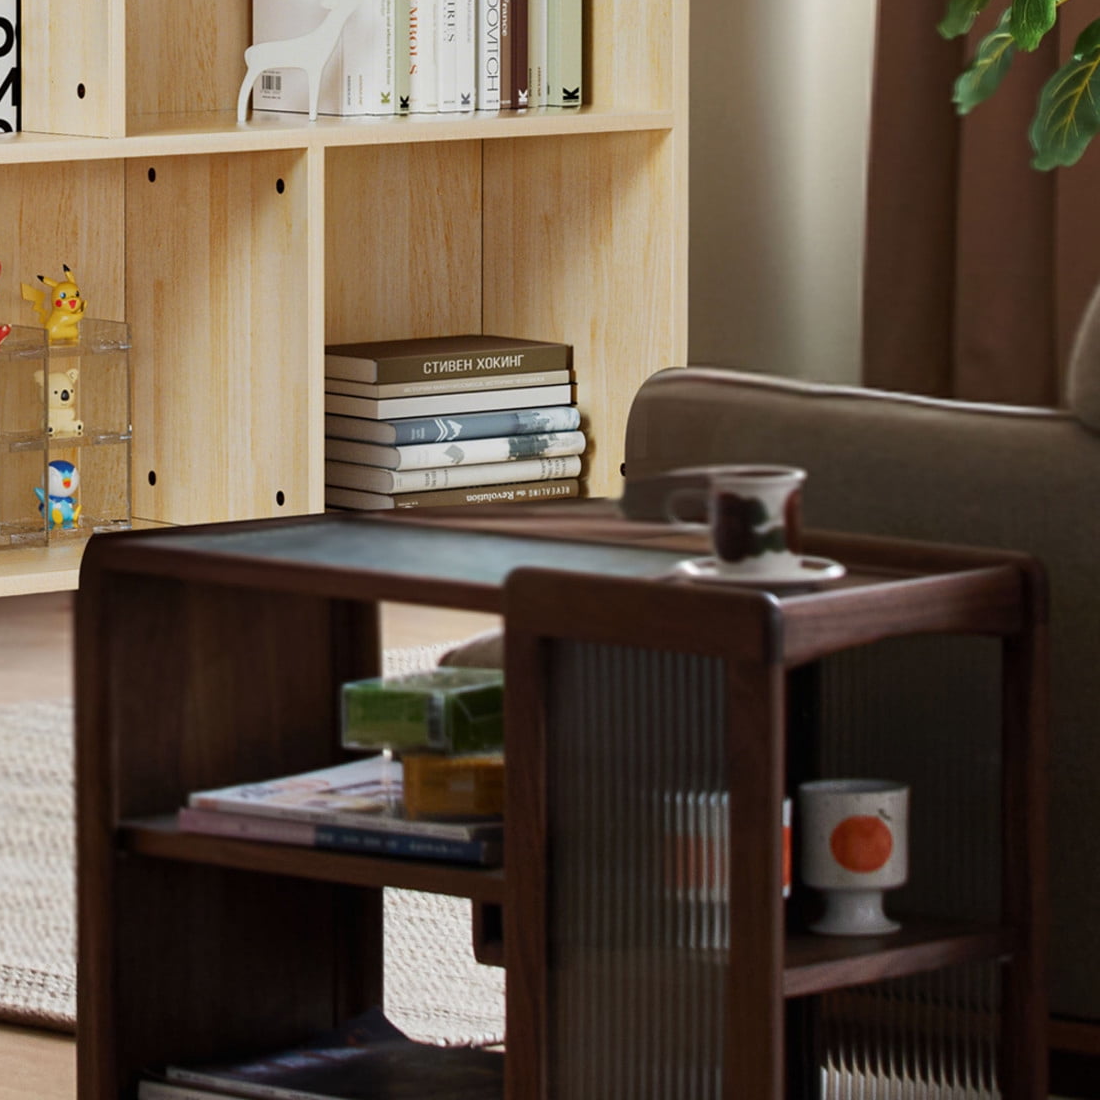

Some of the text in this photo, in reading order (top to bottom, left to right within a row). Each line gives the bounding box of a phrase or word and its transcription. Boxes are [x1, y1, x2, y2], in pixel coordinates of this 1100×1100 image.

[423, 354, 525, 375] СТИВЕН ХОКИНГ
[466, 490, 515, 503] Revolution
[529, 486, 570, 497] REVEALING
